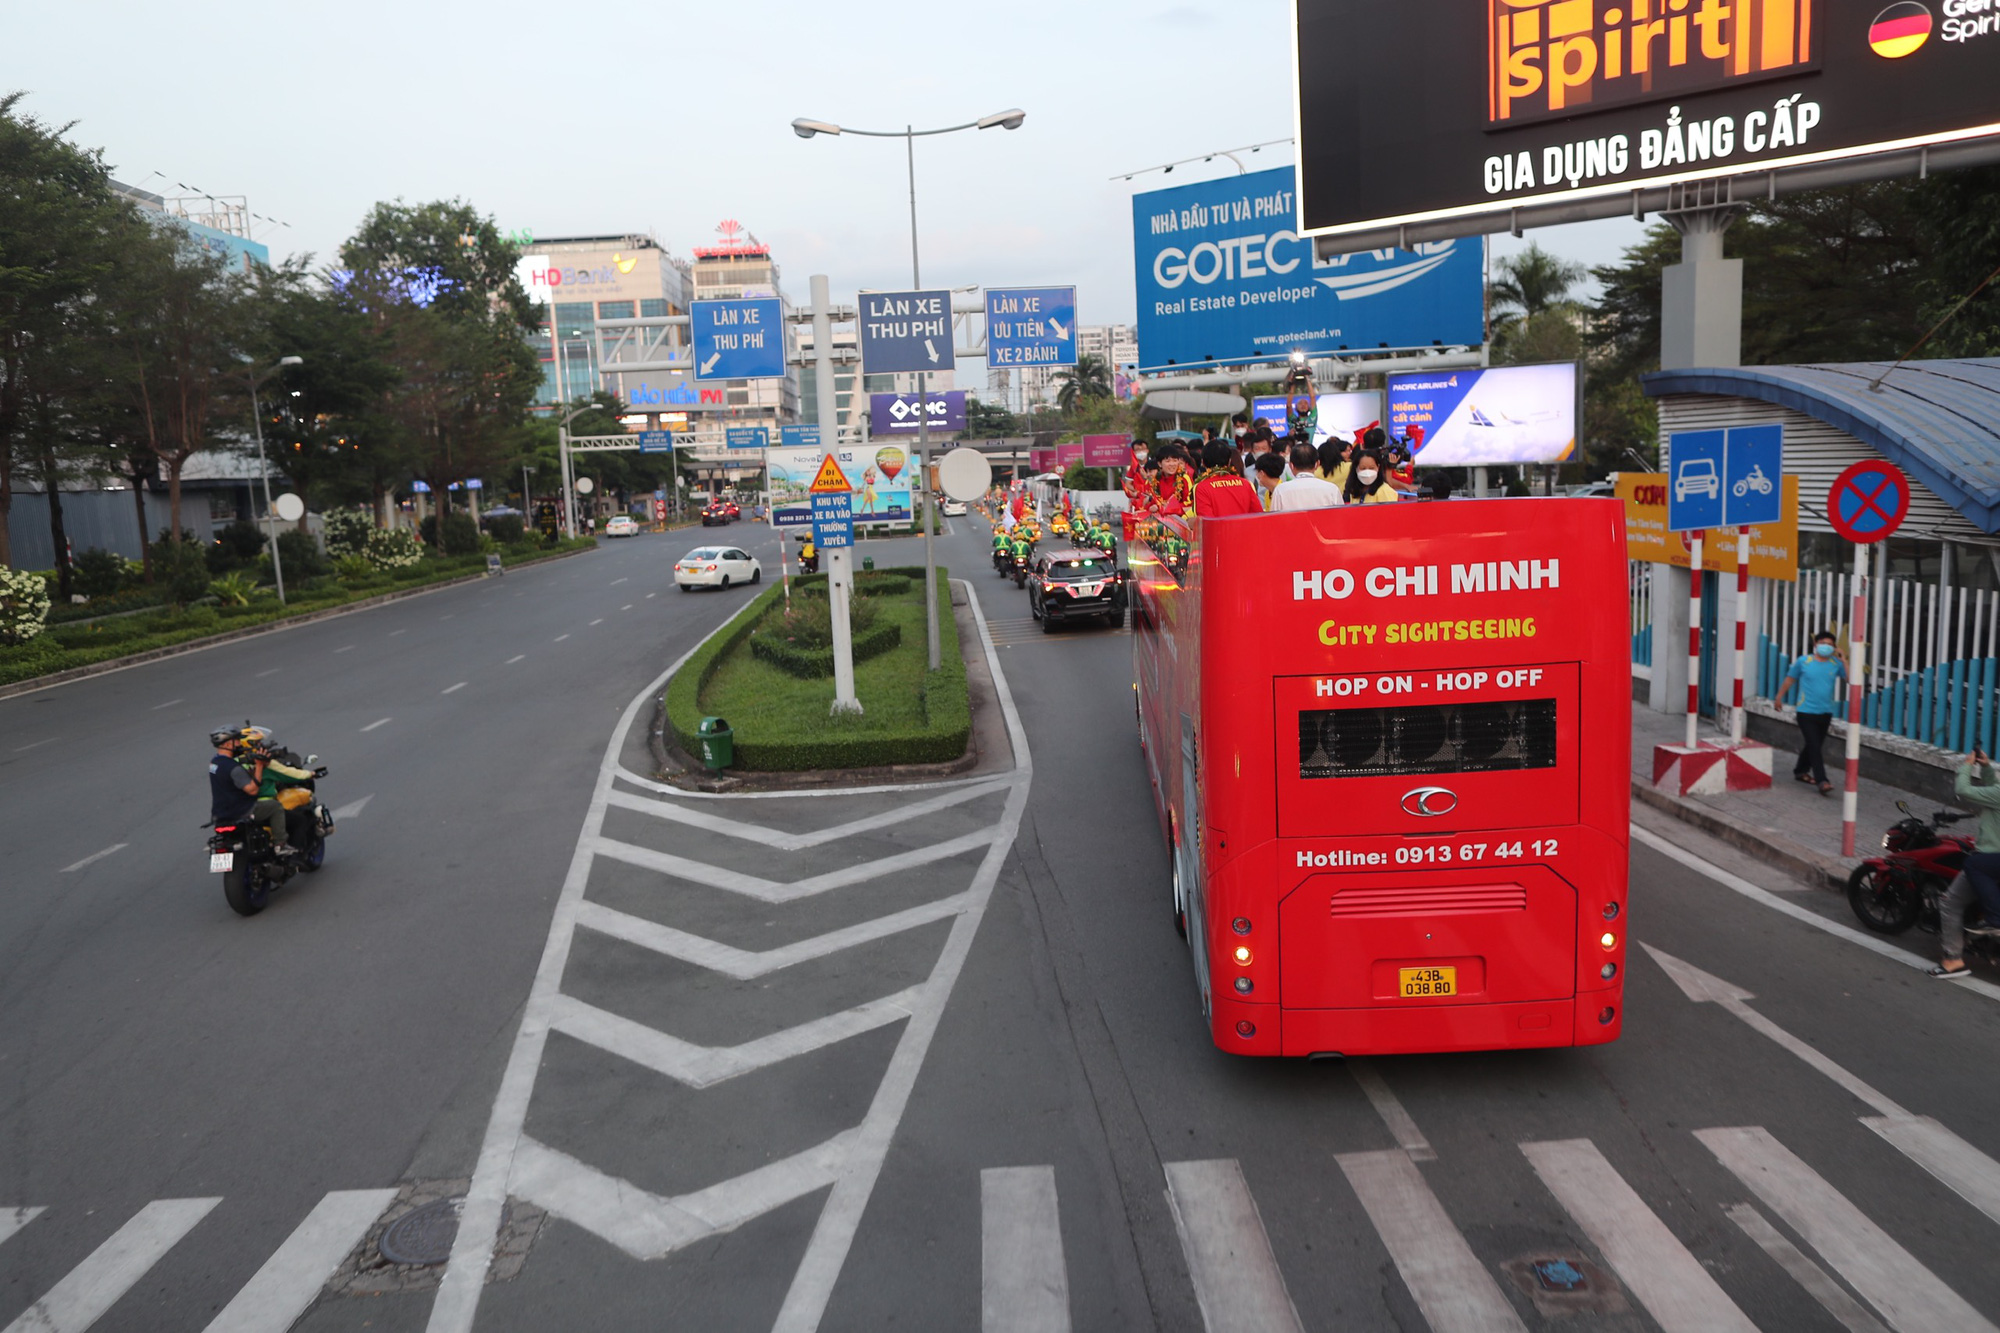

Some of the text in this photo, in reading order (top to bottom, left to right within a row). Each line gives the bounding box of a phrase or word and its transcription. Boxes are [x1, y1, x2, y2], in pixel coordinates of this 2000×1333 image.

[1507, 2, 1731, 110] spirit
[1484, 93, 1821, 194] GIA DỤNG ĐẲNG CẤP
[1151, 189, 1293, 235] NHÀ ĐẦU TƯ VÀ PHÁT
[1153, 229, 1301, 289] GOTEC
[532, 265, 616, 286] HDBank
[870, 297, 942, 317] LÀN XE
[993, 294, 1040, 314] LÀN XE
[1155, 285, 1317, 315] Real Estate Developer
[713, 306, 760, 326] LÀN XE
[867, 317, 944, 339] THU PHÍ
[994, 318, 1044, 338] ƯU TIÊN
[1253, 327, 1341, 345] www.gotecland.vn
[712, 328, 765, 350] THU PHÍ
[996, 341, 1058, 363] XE 2 BÁNH
[630, 381, 723, 404] BẢO HIỂM PVI
[1392, 381, 1448, 391] PACIFIC AIRLINES
[1418, 401, 1434, 410] vui
[1410, 412, 1432, 422] cánh
[1210, 479, 1243, 488] VIETNAM
[816, 495, 847, 507] KHU VỰC
[814, 511, 823, 520] XE
[825, 510, 836, 520] RA
[836, 508, 851, 519] VÀO
[823, 535, 846, 546] XUYÊN
[1292, 558, 1560, 600] HO CHI MINH
[1385, 617, 1536, 643] SIGHTSEEING
[1316, 678, 1369, 697] HOP
[1376, 675, 1413, 694] ON
[1436, 672, 1488, 691] HOP
[1495, 669, 1543, 688] OFF
[1296, 839, 1559, 867] Hotline: 0913 67 44 12
[1415, 970, 1440, 982] 43B
[1405, 982, 1451, 995] 038.80
